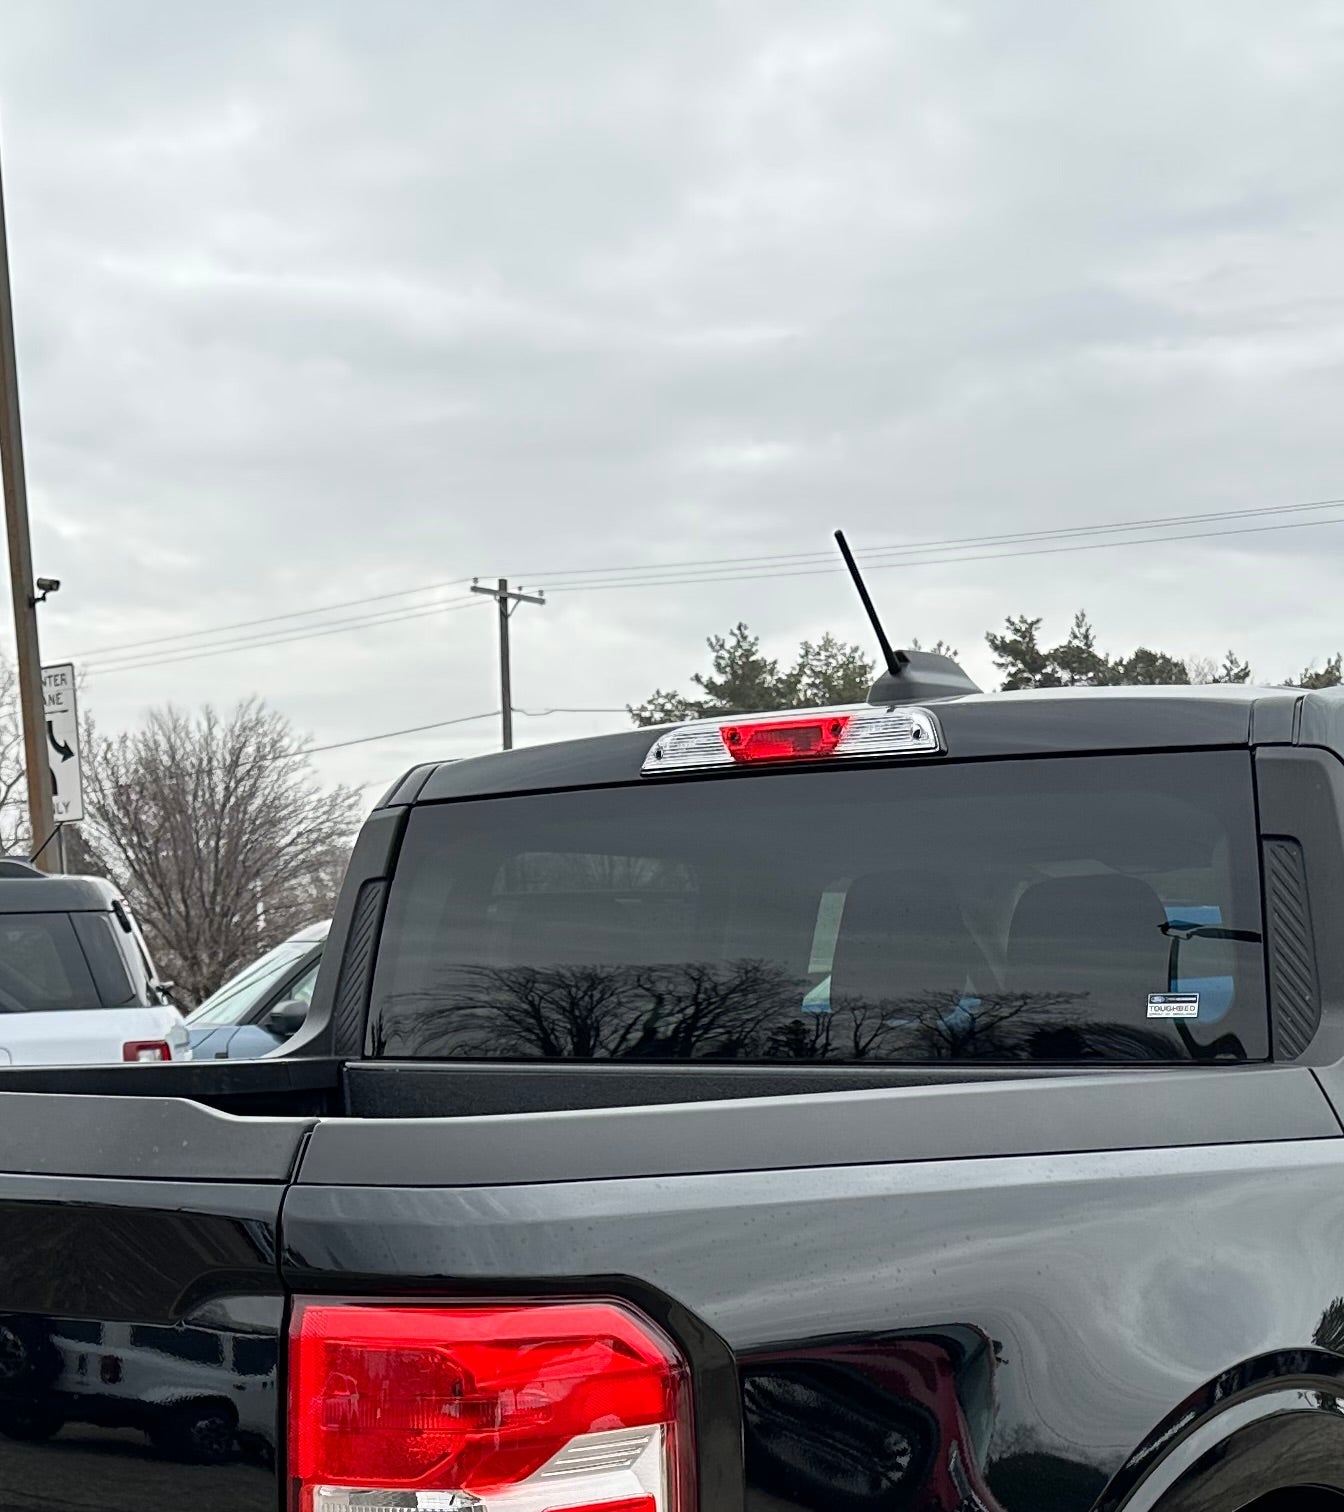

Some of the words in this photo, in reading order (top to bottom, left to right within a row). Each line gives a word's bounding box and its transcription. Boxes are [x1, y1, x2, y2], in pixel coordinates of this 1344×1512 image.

[42, 672, 68, 688] NTER
[44, 692, 64, 706] NE
[53, 800, 72, 815] LY
